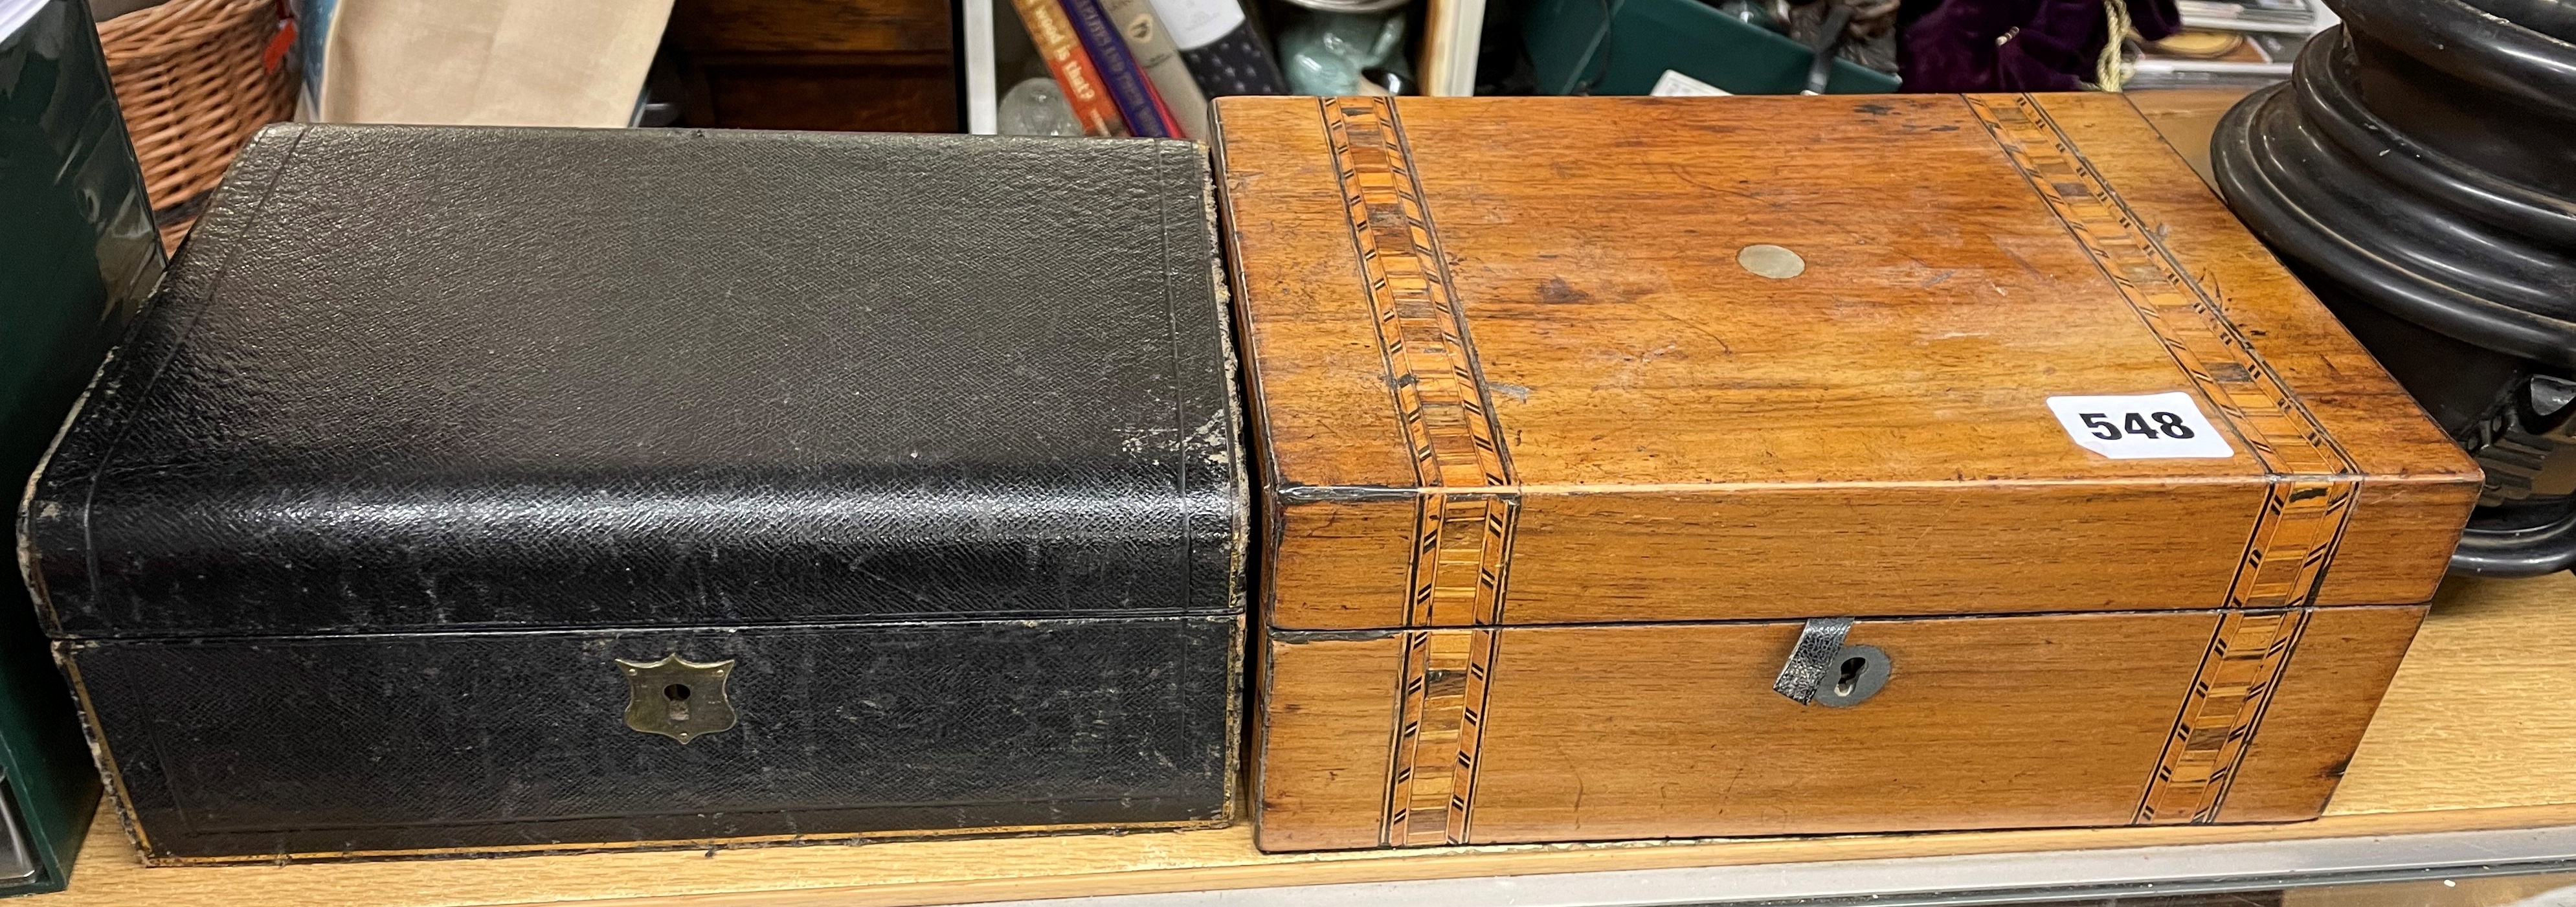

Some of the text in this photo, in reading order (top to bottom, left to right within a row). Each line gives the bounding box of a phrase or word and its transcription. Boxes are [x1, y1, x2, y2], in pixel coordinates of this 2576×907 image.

[1035, 5, 1065, 44] wood
[1054, 45, 1070, 61] is
[1062, 60, 1095, 101] that?
[2078, 412, 2195, 440] 548
